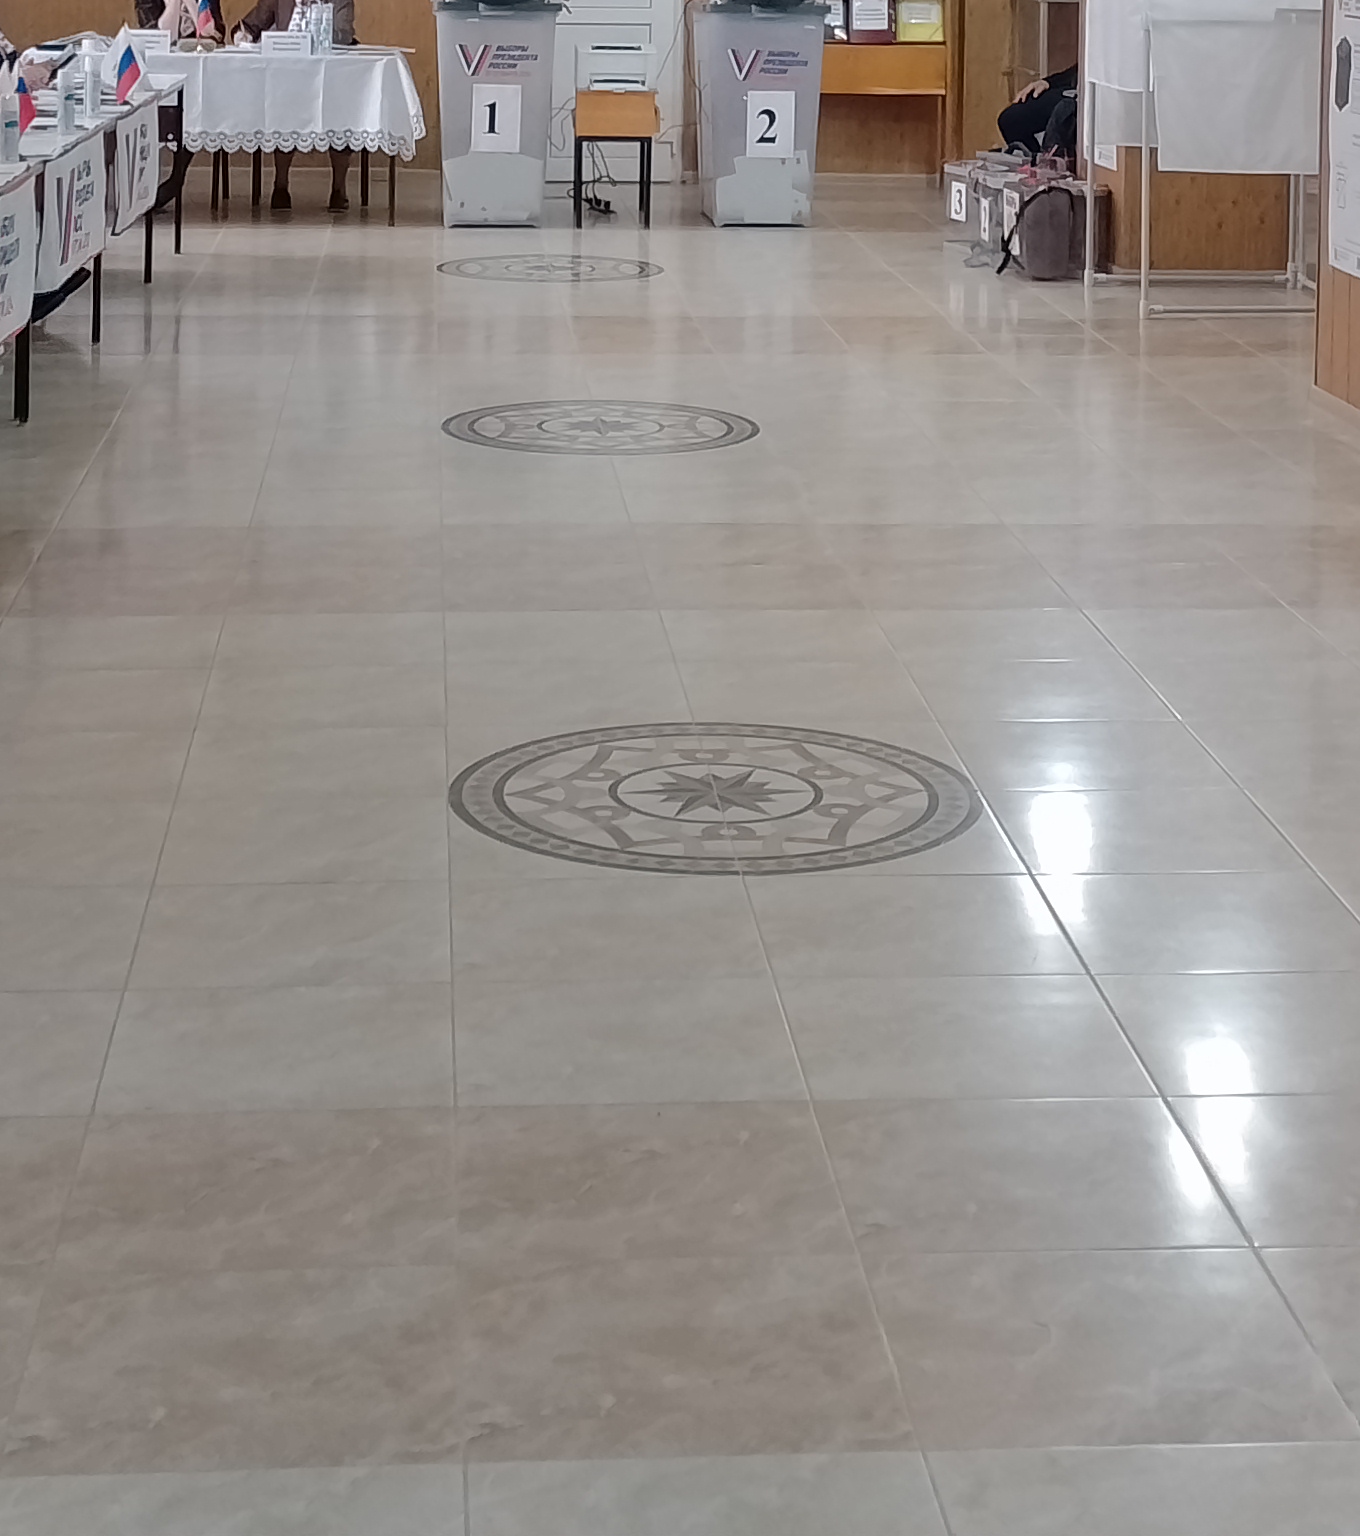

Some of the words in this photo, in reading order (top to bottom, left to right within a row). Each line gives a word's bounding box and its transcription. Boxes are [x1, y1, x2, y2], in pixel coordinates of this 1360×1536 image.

[482, 101, 501, 136] 1
[755, 108, 778, 144] 2
[954, 188, 964, 216] 3
